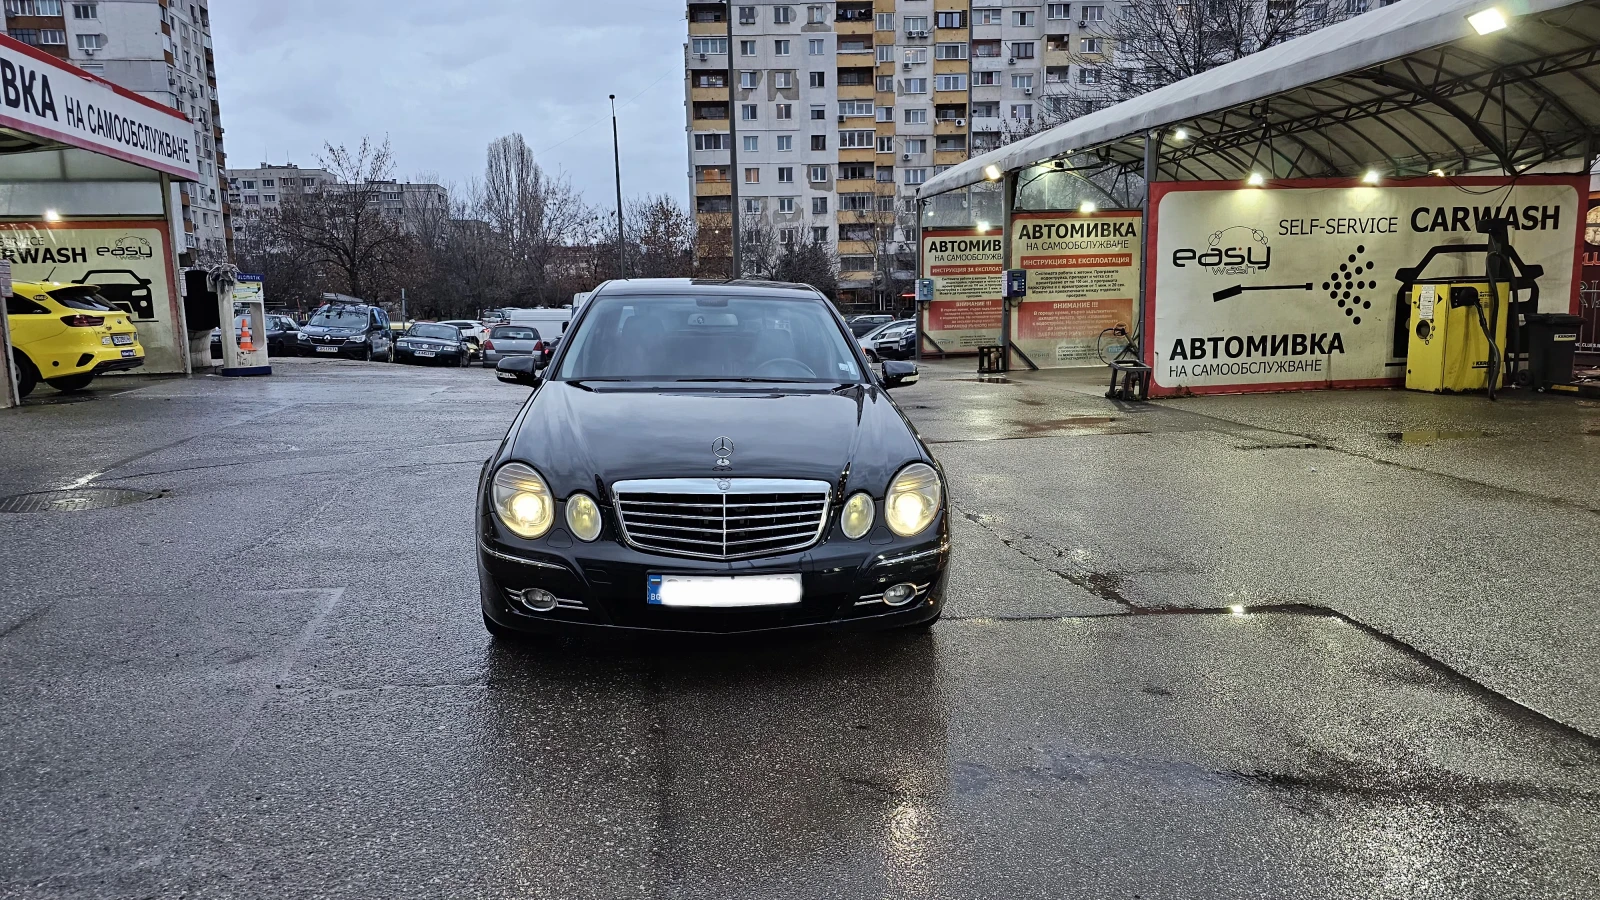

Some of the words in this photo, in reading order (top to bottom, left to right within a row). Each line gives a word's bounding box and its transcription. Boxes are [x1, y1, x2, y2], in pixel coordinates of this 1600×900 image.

[0, 57, 58, 122] ВКА
[64, 95, 86, 131] НА
[87, 104, 190, 164] САМООБСЛУЖВАНЕ
[1278, 217, 1398, 235] SELF-SERVICE
[1411, 205, 1560, 232] CARWASH
[1018, 222, 1137, 240] АВТОМИВКА
[97, 246, 153, 258] easy
[928, 239, 1002, 253] АВТОМИВ
[1026, 242, 1039, 251] НА
[1041, 240, 1129, 251] САМООБСЛУЖВАНЕ
[934, 254, 945, 262] НА
[946, 253, 1003, 262] САМООБСЛУЖВ
[1023, 258, 1067, 266] ИНСТРУКЦИЯ
[1078, 256, 1130, 264] ЕКСПЛОАТАЦИЯ
[1173, 246, 1270, 269] easy
[1212, 264, 1256, 275] wash
[1169, 333, 1345, 361] АВТОМИВКА
[1169, 365, 1188, 378] НА
[1191, 359, 1322, 377] САМООБСЛУЖВАНЕ
[650, 593, 661, 601] BG
